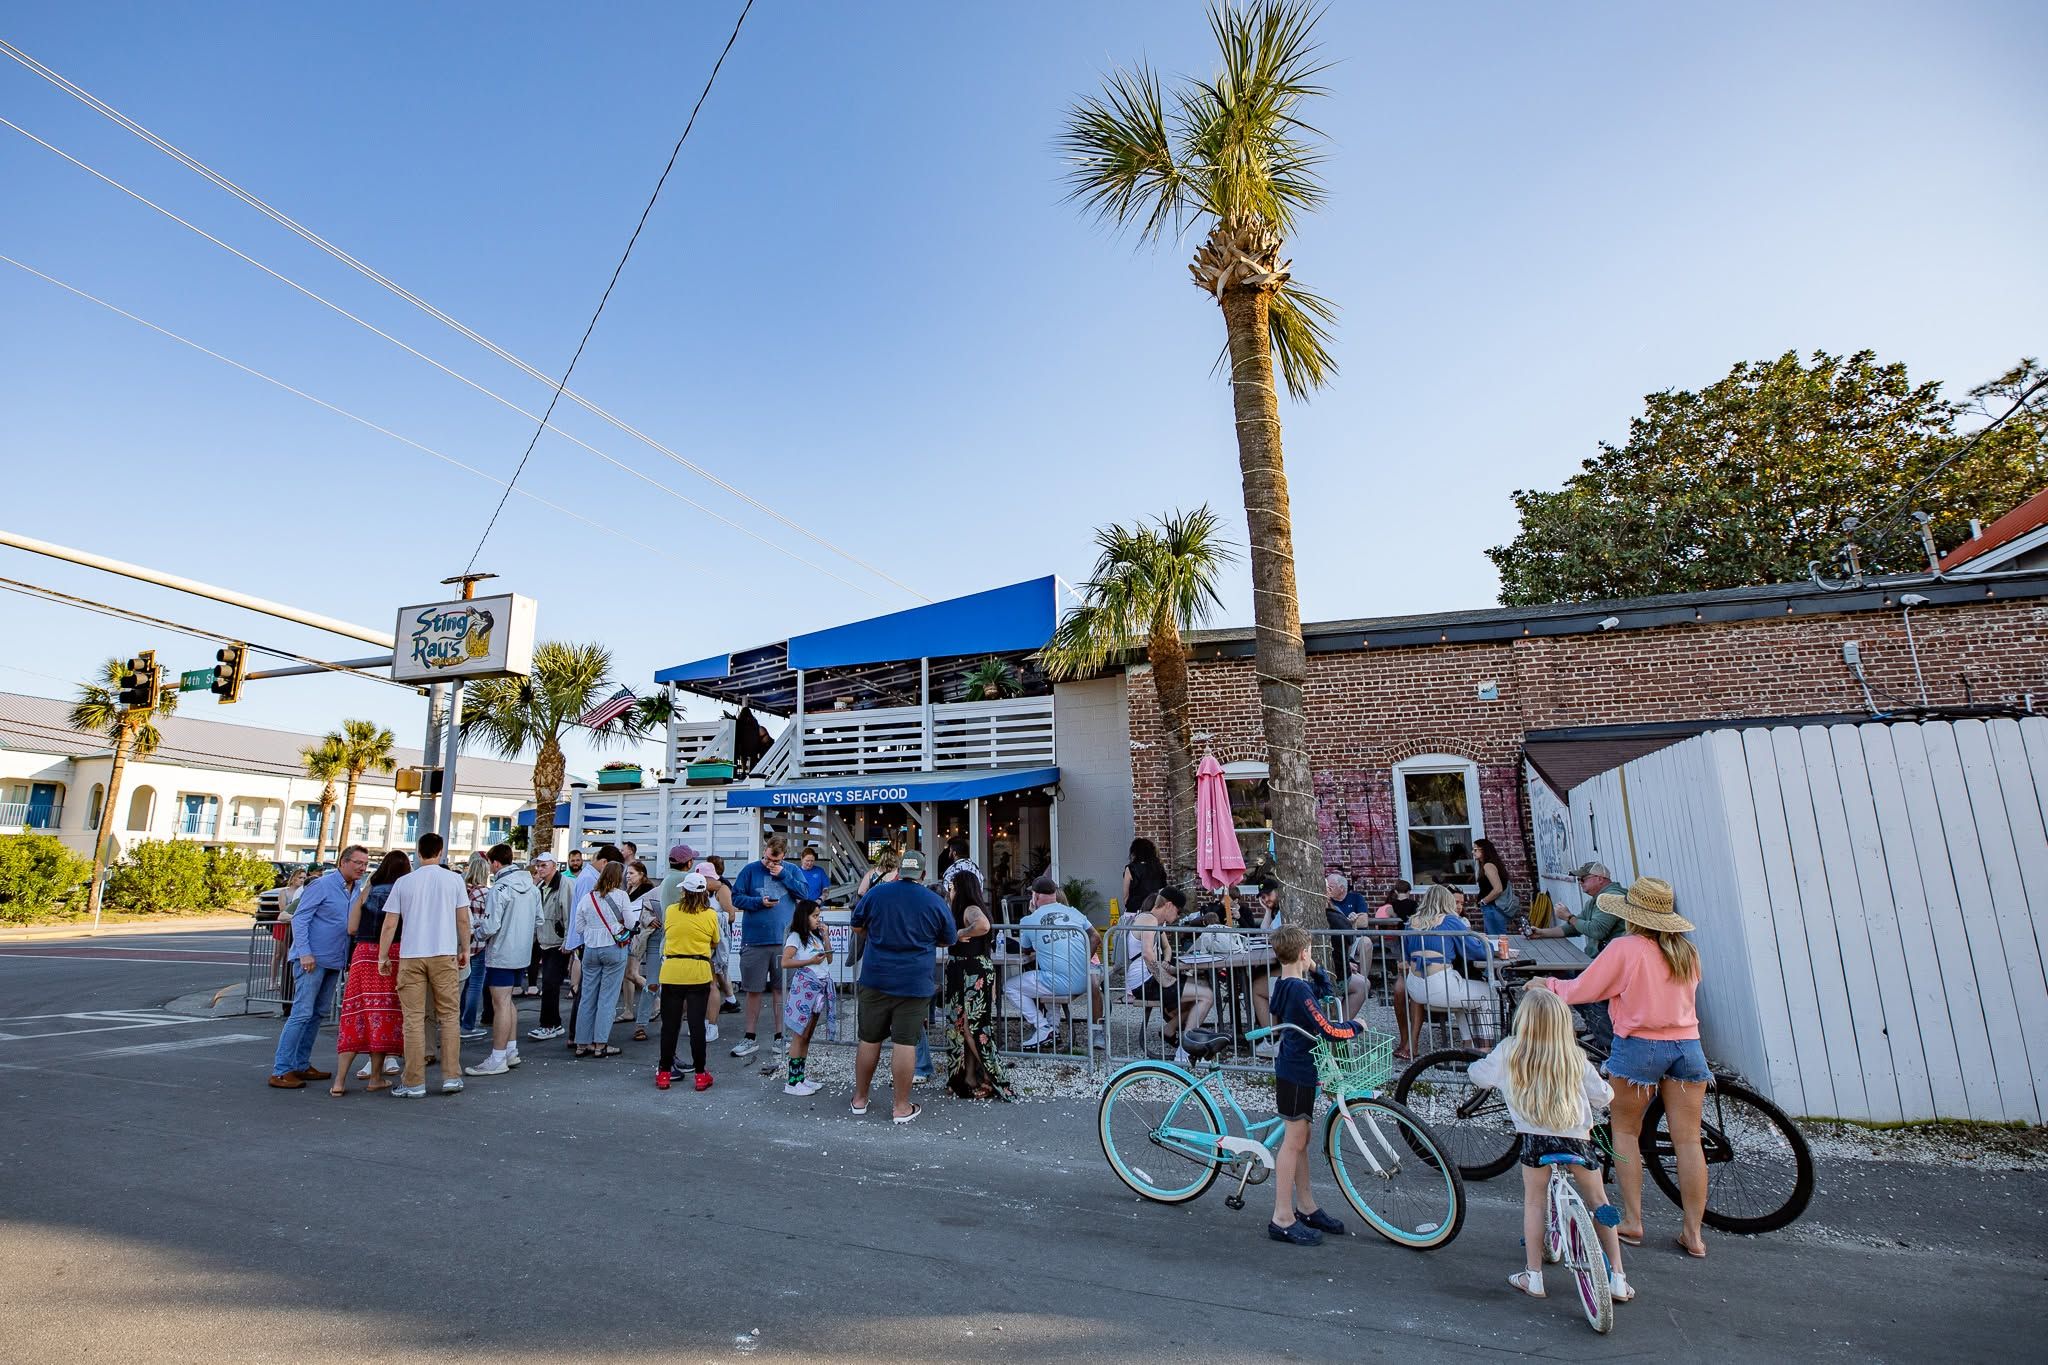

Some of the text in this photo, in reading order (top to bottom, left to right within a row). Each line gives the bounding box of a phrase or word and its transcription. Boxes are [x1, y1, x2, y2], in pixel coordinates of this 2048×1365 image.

[412, 607, 468, 638] Sting
[410, 637, 463, 669] Ray's
[183, 673, 215, 687] 14th St
[773, 788, 908, 805] STINGRAY'S SEAFOOD
